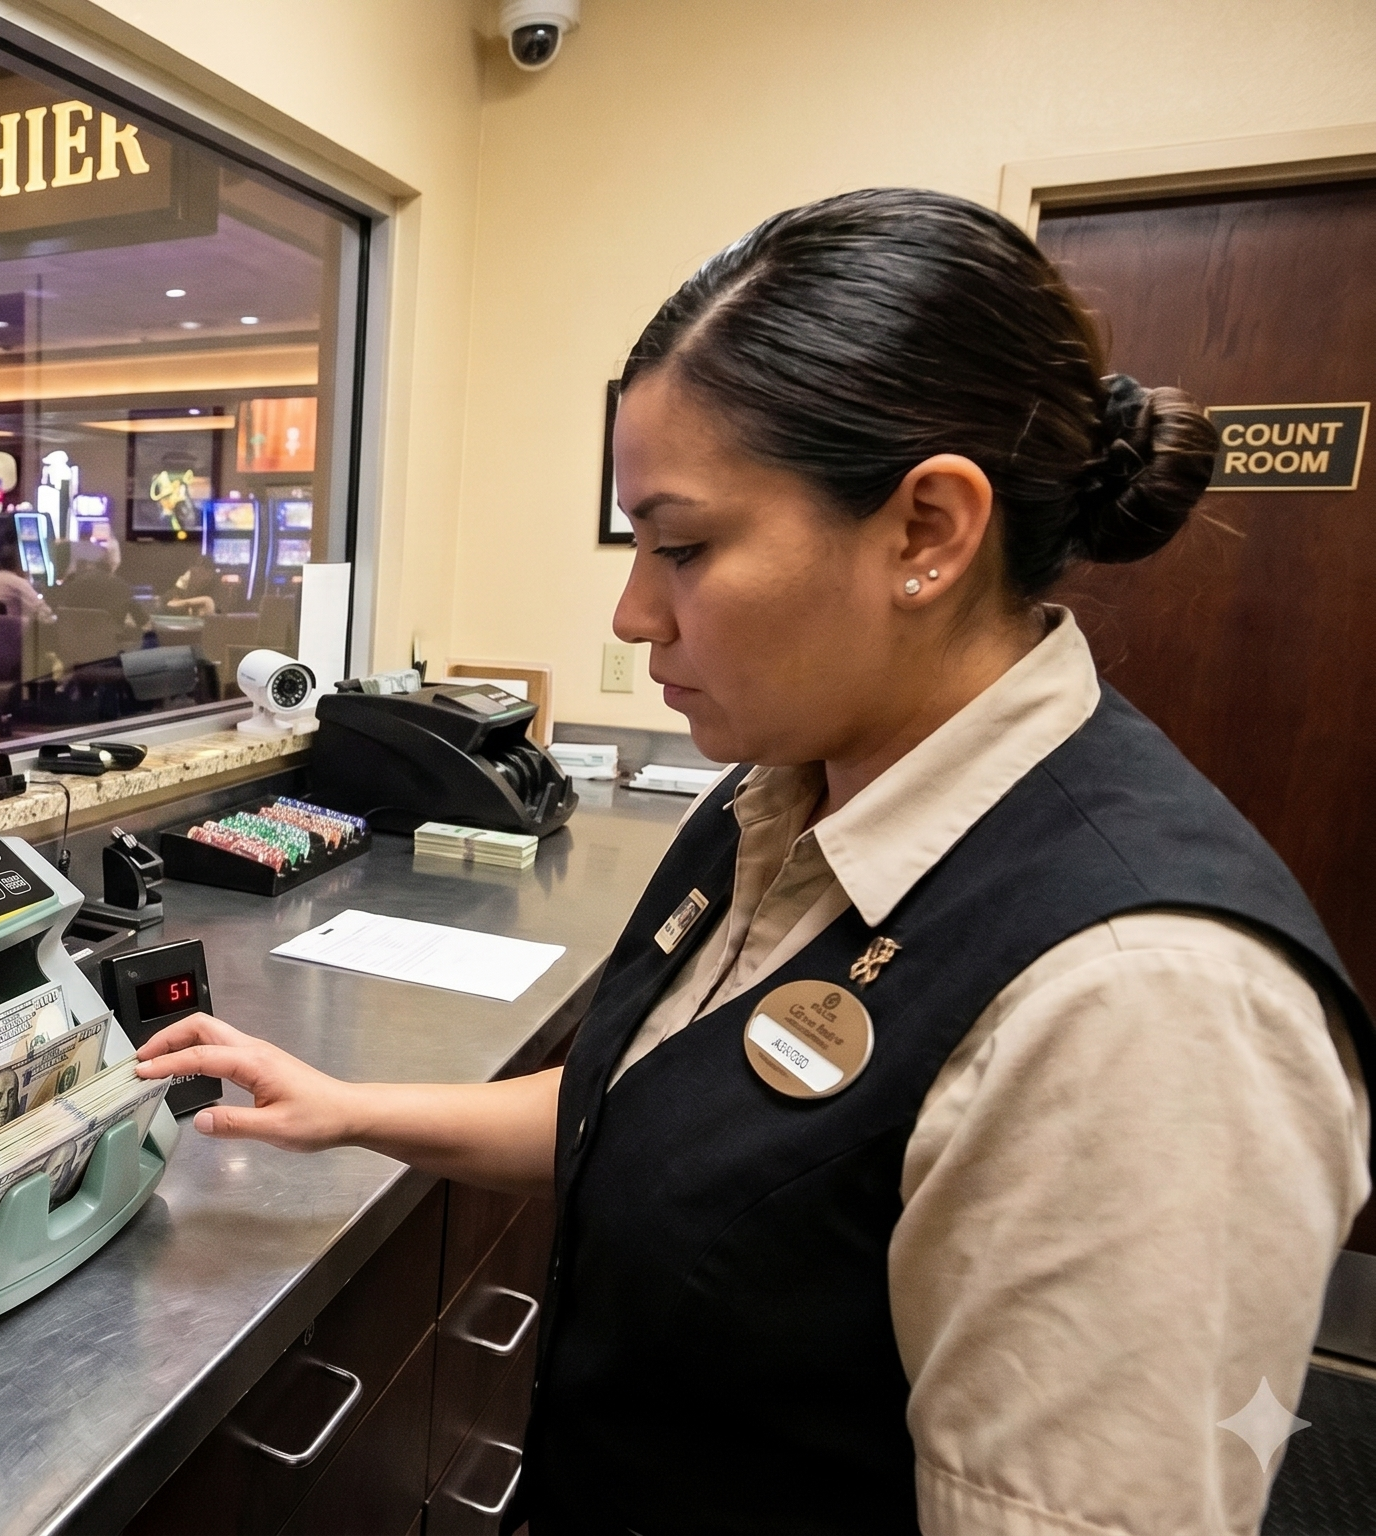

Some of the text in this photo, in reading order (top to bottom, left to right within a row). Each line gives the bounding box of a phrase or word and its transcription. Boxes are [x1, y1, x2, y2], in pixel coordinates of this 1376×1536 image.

[1221, 422, 1344, 447] COUNT
[1224, 450, 1330, 474] ROOM
[170, 980, 190, 1001] 57
